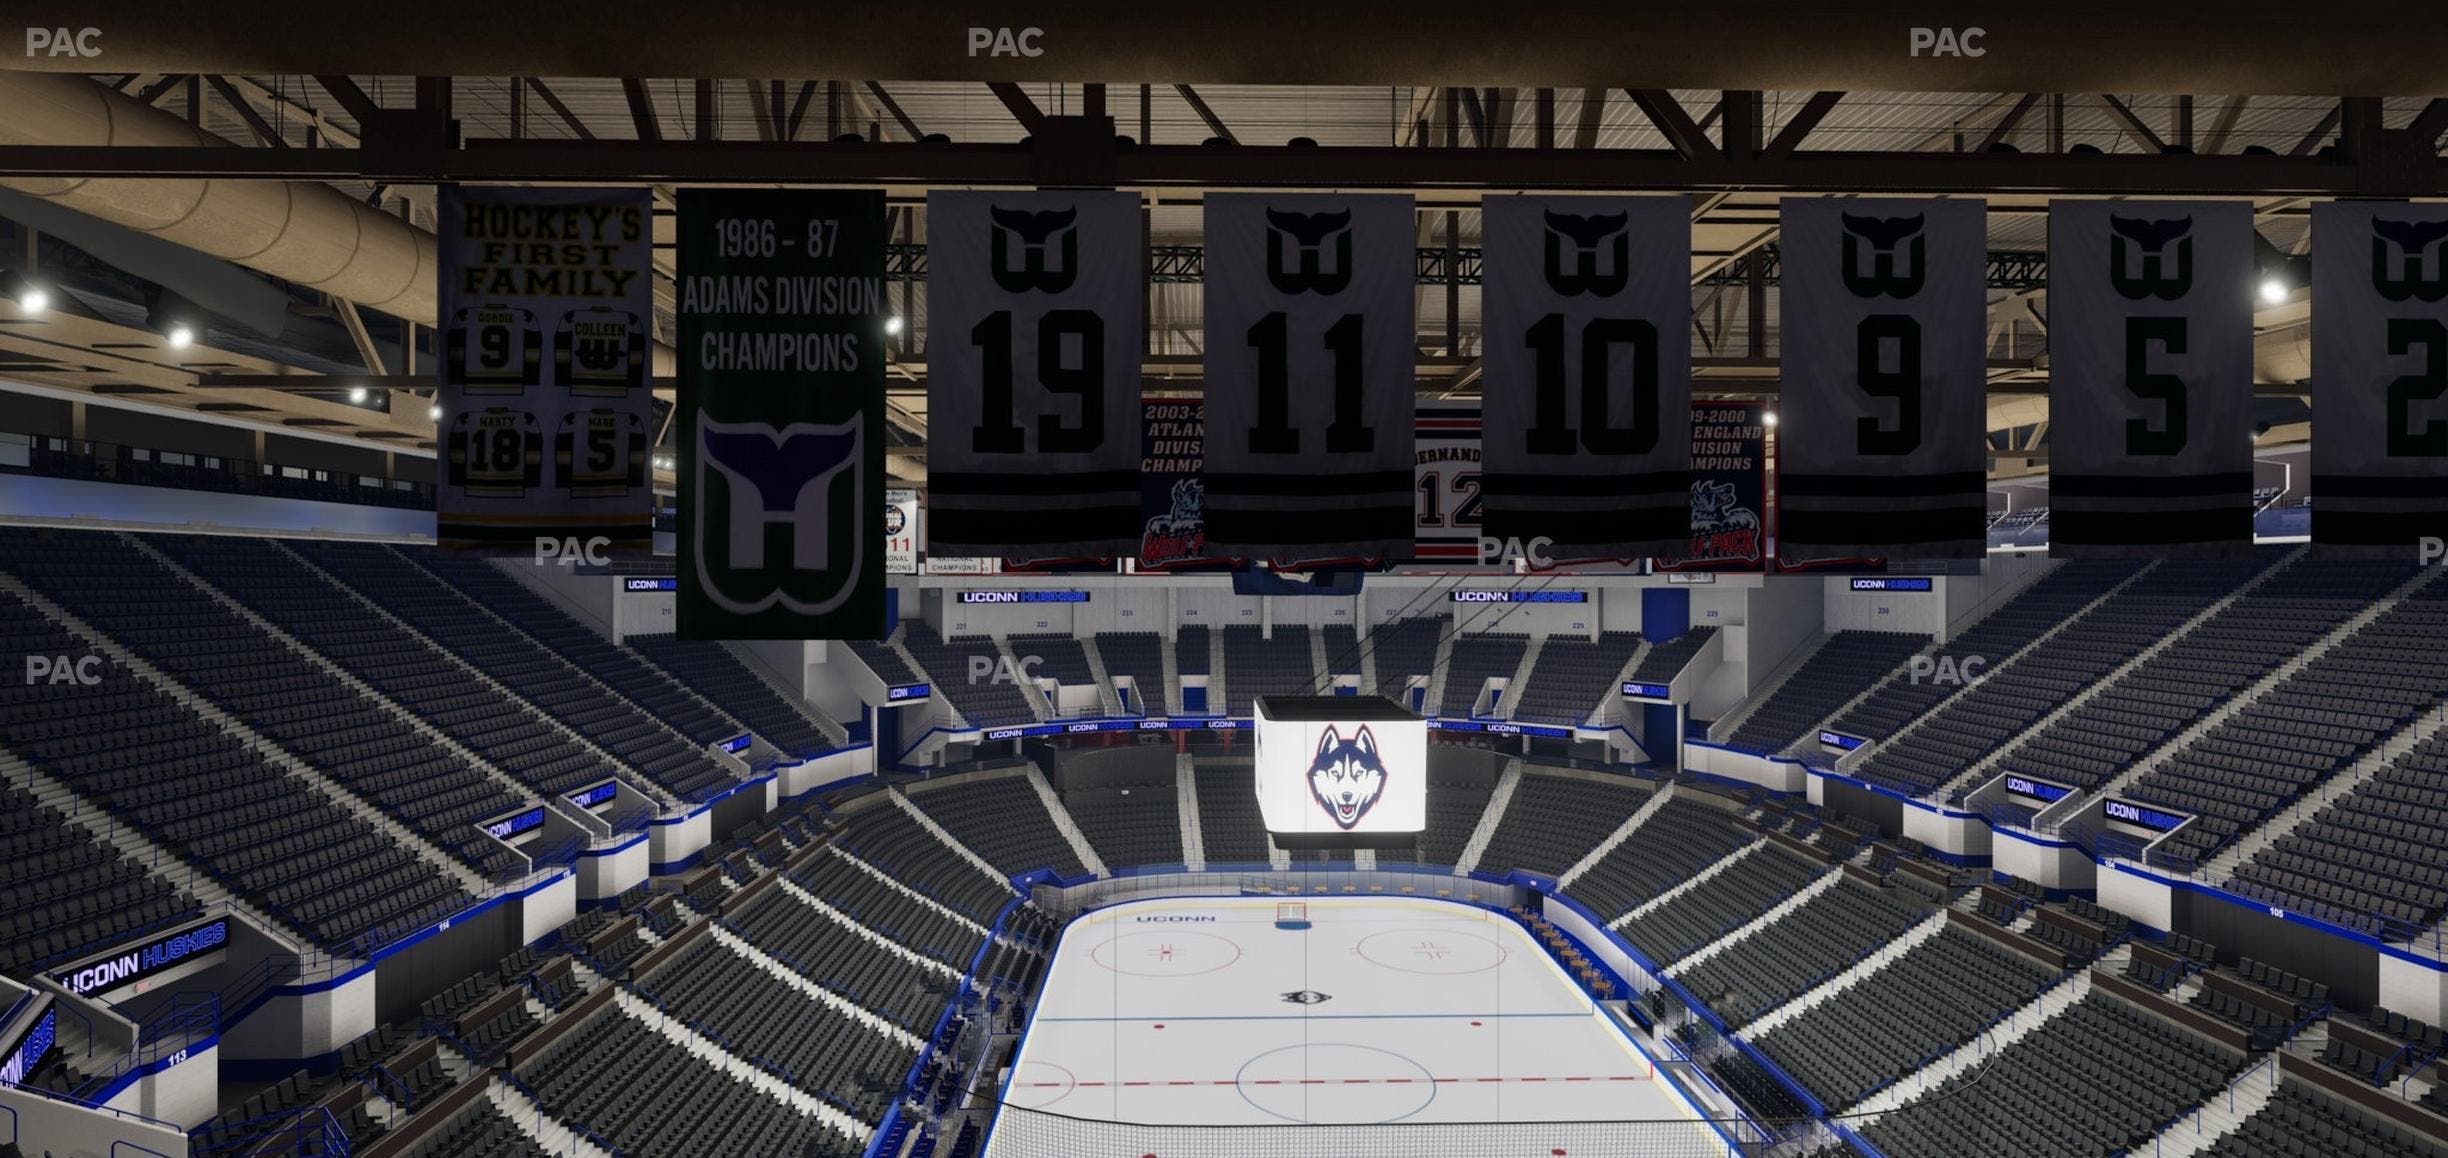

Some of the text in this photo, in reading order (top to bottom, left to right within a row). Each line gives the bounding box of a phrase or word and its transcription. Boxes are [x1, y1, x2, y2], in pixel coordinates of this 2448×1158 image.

[464, 202, 641, 240] HOCKEY'S
[482, 243, 620, 266] FIRST
[714, 218, 776, 259] 1986
[807, 218, 839, 259] 87
[464, 268, 637, 296] FAMILY
[679, 274, 880, 316] ADAMS DIVISION
[481, 325, 510, 367] 9
[575, 323, 625, 336] COLLEEN
[700, 332, 859, 372] CHAMPIONS
[971, 310, 1104, 453] 19
[1247, 312, 1375, 453] 11
[1525, 313, 1659, 455] 10
[1857, 315, 1922, 455] 9
[2126, 317, 2187, 456] 5
[2387, 319, 2447, 457] 2
[1693, 426, 1762, 439] ENGLAND
[472, 430, 520, 471] 18
[588, 430, 616, 471] 5
[1415, 447, 1481, 465] ERNAND
[1417, 471, 1483, 528] 12
[628, 580, 658, 589] UCONN
[964, 592, 1018, 602] UCONN
[1455, 591, 1509, 602] UCONN
[1853, 580, 1885, 589] UCONN
[989, 729, 1022, 739] UCONN
[1068, 723, 1098, 732] UCONN
[1487, 724, 1520, 733] UCONN
[2007, 777, 2035, 794] UCONN
[2106, 801, 2139, 821] UCONN
[62, 922, 226, 994] UCONN HUSKIES
[168, 1050, 187, 1066] 113
